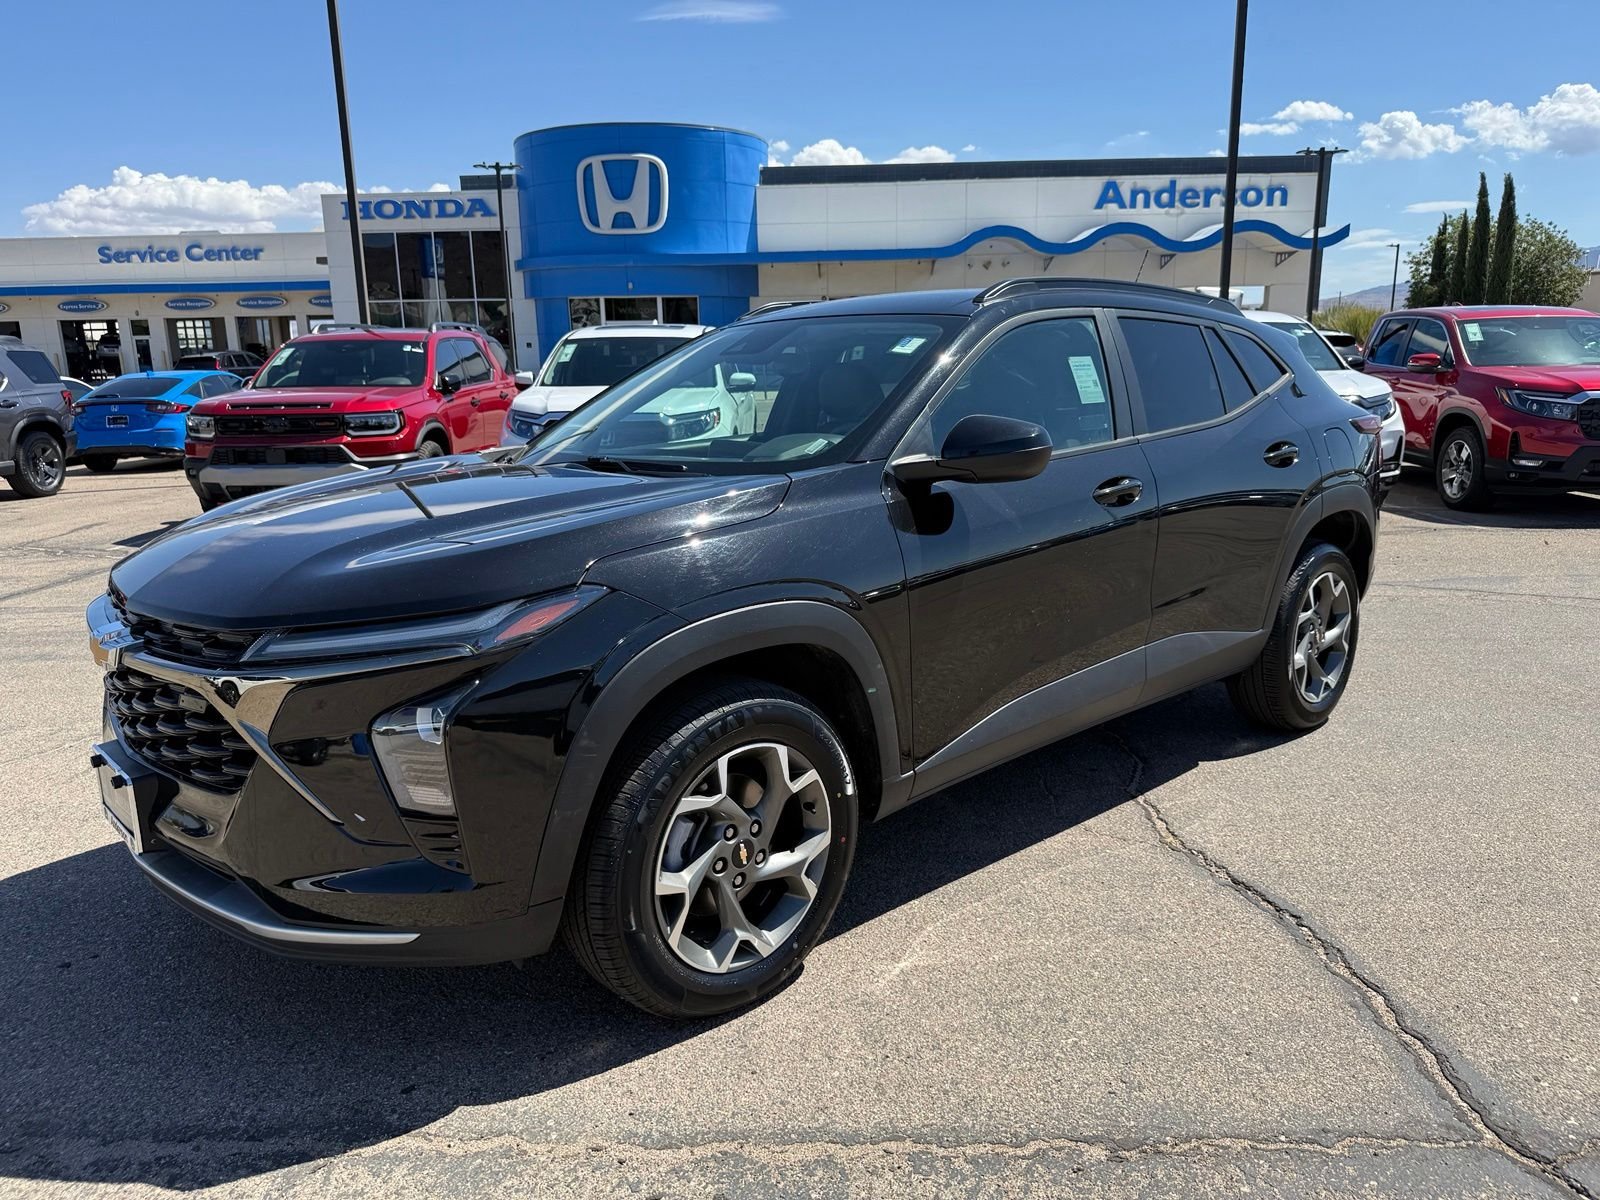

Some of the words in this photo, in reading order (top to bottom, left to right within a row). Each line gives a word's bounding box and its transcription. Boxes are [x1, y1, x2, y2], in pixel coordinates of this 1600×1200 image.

[340, 198, 497, 220] HONDA
[98, 244, 180, 264] Service
[185, 241, 264, 262] Center
